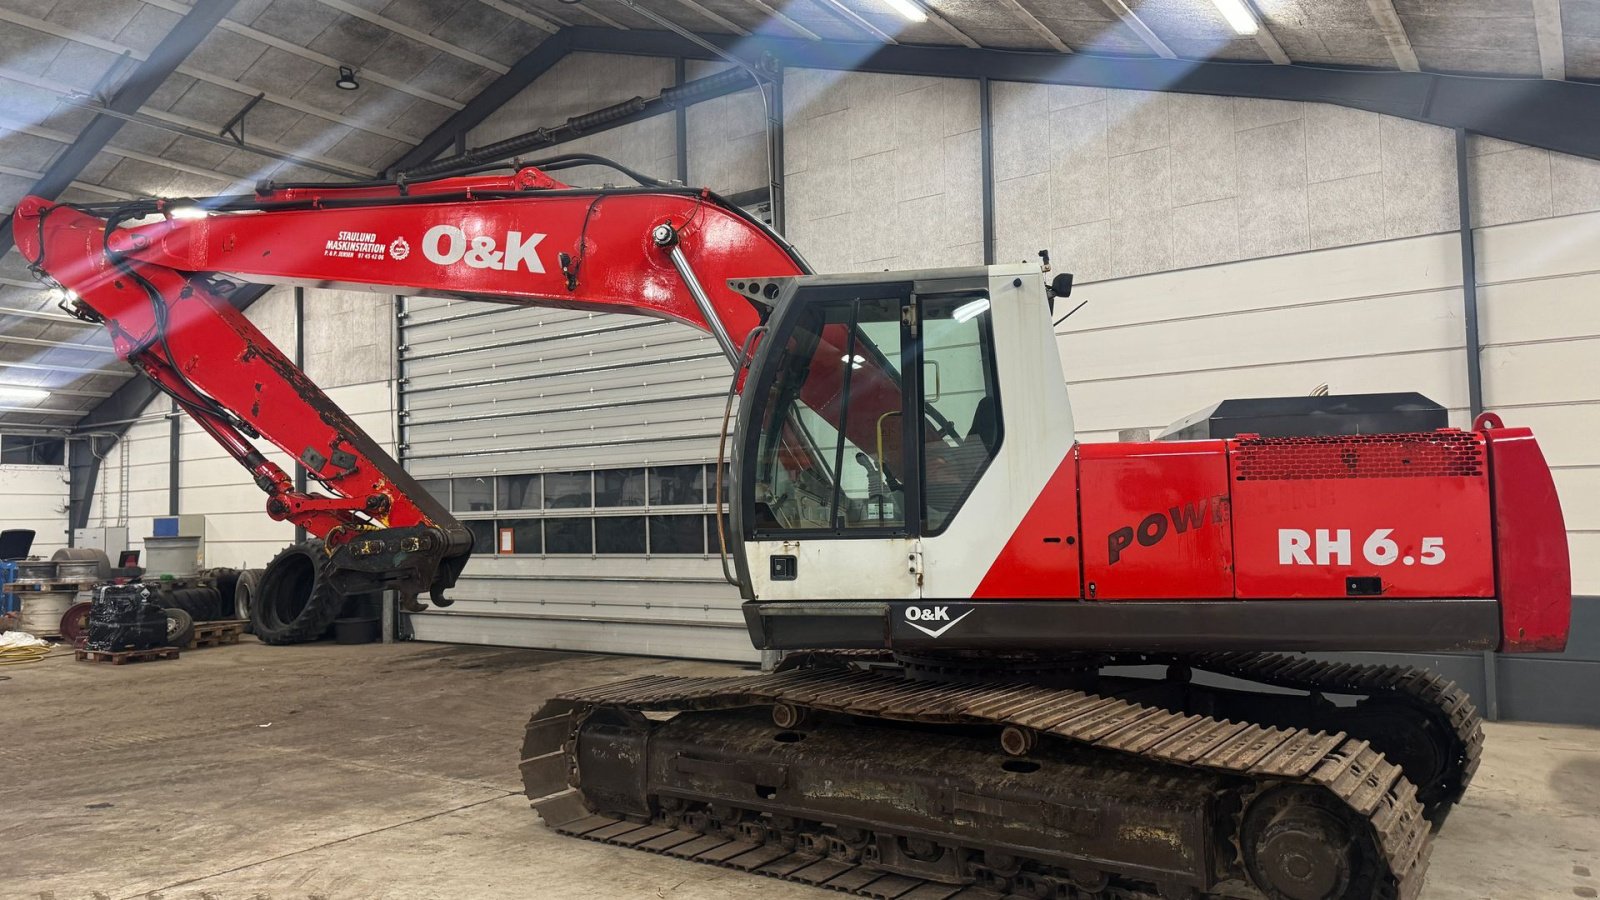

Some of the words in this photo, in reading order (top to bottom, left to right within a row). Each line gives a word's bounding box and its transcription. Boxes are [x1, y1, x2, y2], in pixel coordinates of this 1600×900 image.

[338, 231, 377, 243] STAULUND
[326, 240, 386, 254] MASKINSTATION
[422, 224, 547, 274] O&K
[1278, 528, 1351, 566] RH
[1363, 528, 1446, 566] 6.5
[905, 606, 950, 621] O&K
